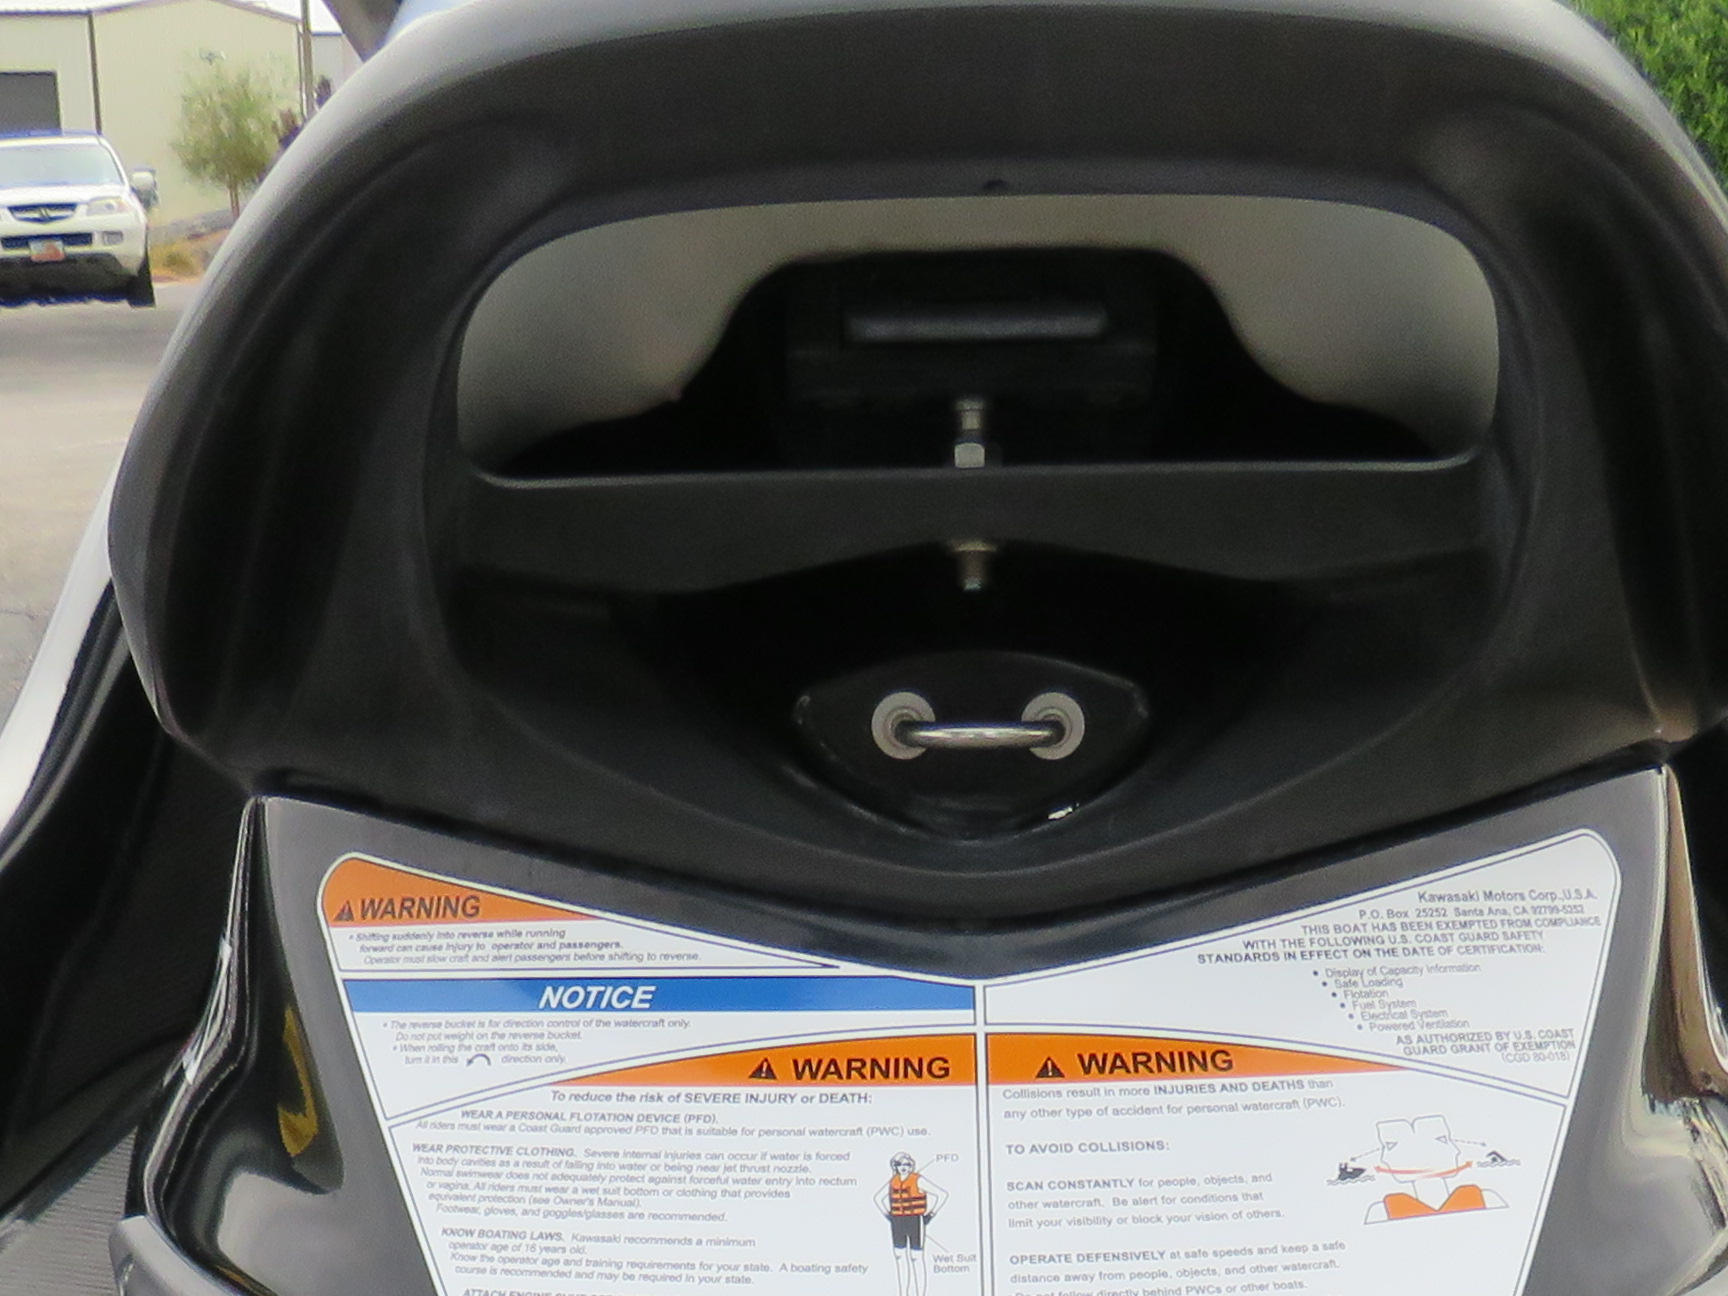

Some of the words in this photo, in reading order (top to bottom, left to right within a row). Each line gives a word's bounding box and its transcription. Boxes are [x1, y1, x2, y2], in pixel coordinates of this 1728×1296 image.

[1417, 890, 1480, 902] Kawasaki
[1482, 890, 1526, 901] Motors
[360, 895, 480, 920] WARNING
[1301, 924, 1330, 935] THIS
[1332, 923, 1367, 934] BOAT
[1371, 921, 1397, 932] HAS
[1400, 920, 1433, 931] BEEN
[1435, 919, 1498, 930] EXEMPTED
[1500, 918, 1532, 928] FROM
[1534, 916, 1601, 927] COMPLIANCE
[1242, 939, 1276, 949] WITH
[1280, 938, 1305, 948] THE
[1308, 935, 1385, 947] FOLLOWING
[1387, 933, 1410, 944] U.S.
[1414, 932, 1454, 943] COAST
[1458, 931, 1499, 942] GUARD
[1502, 929, 1543, 940] SAFETY
[1197, 951, 1280, 963] STANDARDS
[1283, 951, 1297, 960] IN
[1300, 949, 1348, 960] EFFECT
[1352, 948, 1371, 958] ON
[1374, 947, 1398, 957] THE
[1402, 946, 1434, 956] DATE
[1437, 945, 1452, 956] OF
[538, 985, 657, 1010] NOTICE
[1396, 1034, 1413, 1045] AS
[1416, 1031, 1492, 1044] AUTHORIZED
[1494, 1031, 1510, 1041] BY
[1513, 1029, 1537, 1040] U.S.
[1538, 1028, 1573, 1039] COAST
[1403, 1044, 1447, 1056] GUARD
[1450, 1042, 1490, 1054] GRANT
[1494, 1042, 1509, 1052] OF
[1512, 1039, 1576, 1051] EXEMPTION
[793, 1057, 950, 1081] WARNING
[1077, 1050, 1234, 1075] WARNING
[552, 1090, 566, 1101] To
[568, 1092, 612, 1101] reduce
[616, 1092, 636, 1102] the
[639, 1092, 663, 1102] risk
[667, 1092, 681, 1102] of
[684, 1092, 741, 1103] SEVERE
[744, 1093, 797, 1103] INJURY
[800, 1095, 815, 1103] or
[818, 1092, 872, 1103] DEATH:
[1002, 1088, 1062, 1099] Collisions
[1066, 1087, 1100, 1097] result
[1104, 1086, 1115, 1096] in
[1118, 1087, 1150, 1096] more
[1153, 1083, 1216, 1095] INJURIES
[1219, 1082, 1248, 1092] AND
[1251, 1079, 1305, 1091] DEATHS
[1307, 1078, 1333, 1089] than
[460, 1109, 493, 1119] WEAR
[495, 1110, 503, 1119] A
[505, 1110, 565, 1120] PERSONAL
[569, 1112, 634, 1122] FLOTATION
[636, 1113, 680, 1123] DEVICE
[683, 1113, 718, 1123] (PFD).
[412, 1143, 443, 1153] WEAR
[445, 1144, 513, 1155] PROTECTIVE
[516, 1146, 576, 1157] CLOTHING.
[1006, 1144, 1025, 1154] TO
[1029, 1142, 1073, 1154] AVOID
[1078, 1140, 1169, 1152] COLLISIONS:
[936, 1153, 959, 1162] PFD
[1006, 1180, 1043, 1191] SCAN
[1047, 1178, 1134, 1190] CONSTANTLY
[1138, 1177, 1153, 1187] for
[1251, 1173, 1272, 1182] and
[441, 1227, 476, 1237] KNOW
[477, 1228, 527, 1240] BOATING
[529, 1231, 564, 1241] LAWS.
[932, 1254, 954, 1263] Wet
[956, 1253, 977, 1262] Suit
[1009, 1253, 1072, 1265] OPERATE
[1076, 1249, 1165, 1263] DEFENSIVELY
[932, 1264, 970, 1273] Bottom
